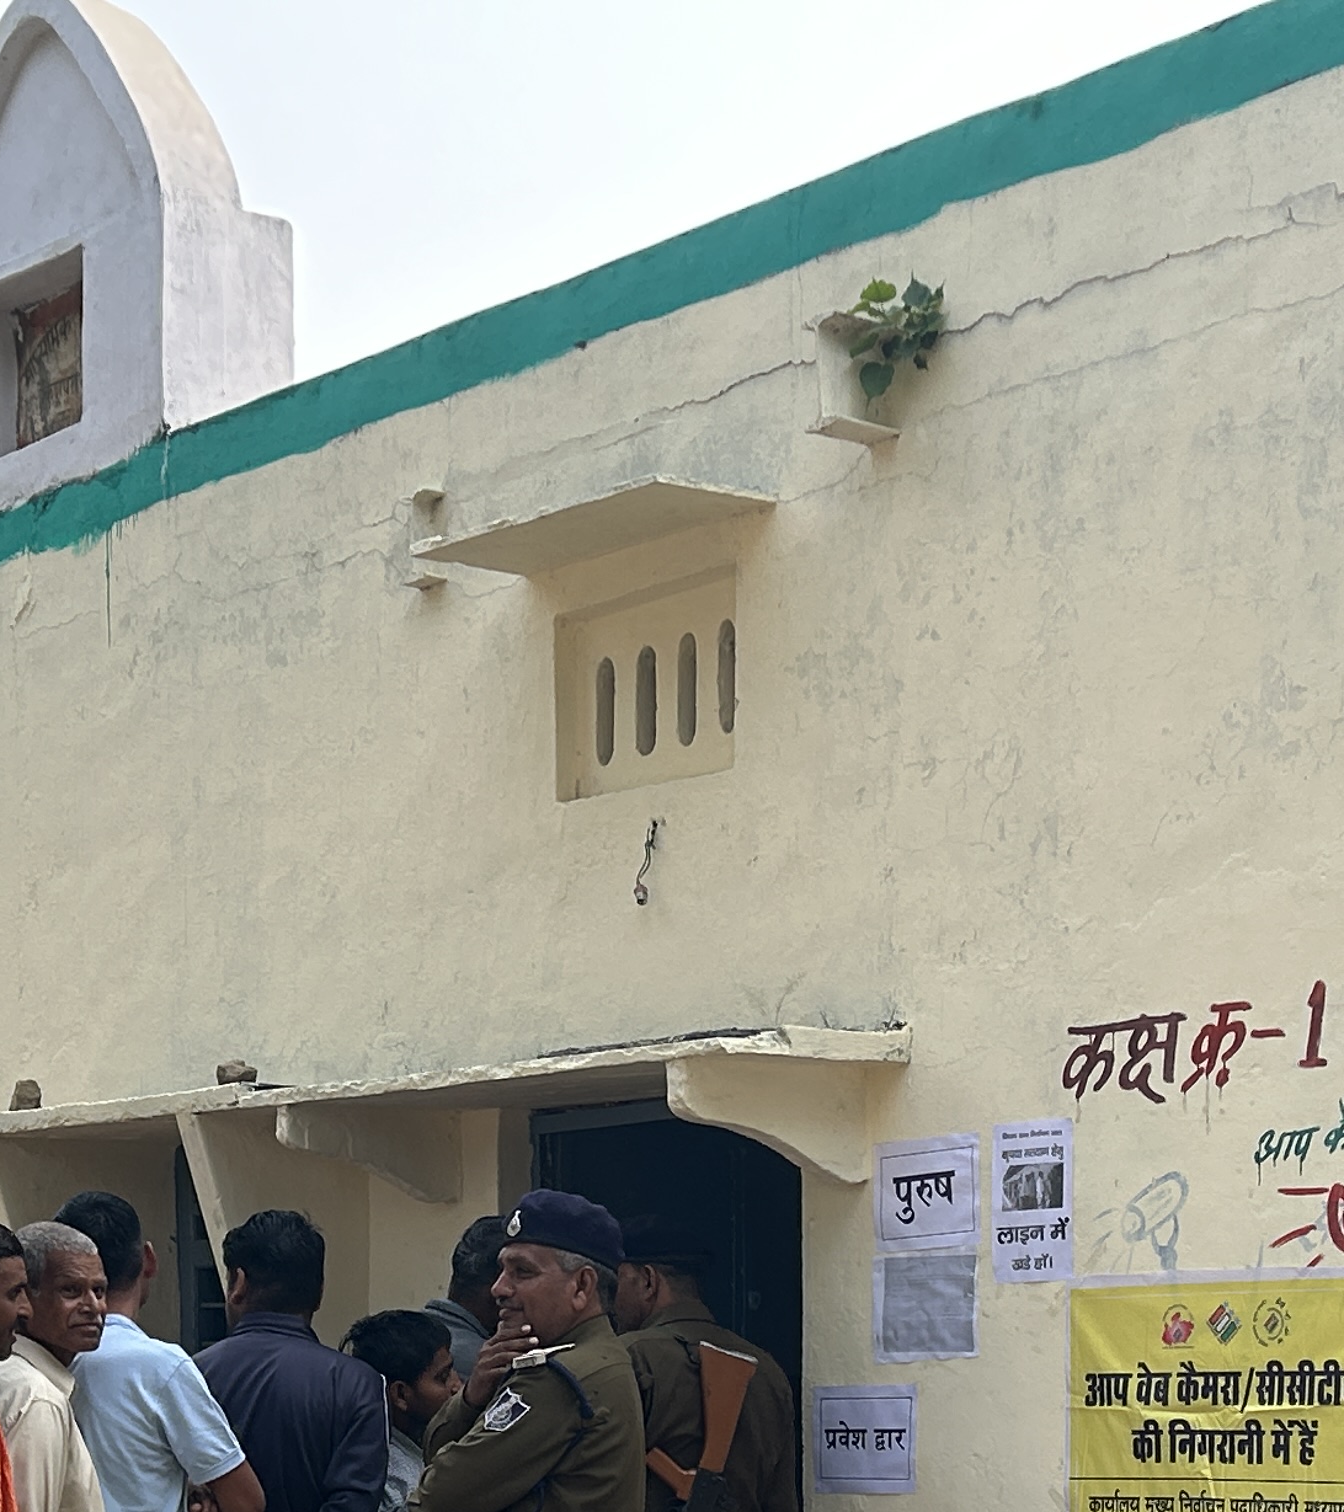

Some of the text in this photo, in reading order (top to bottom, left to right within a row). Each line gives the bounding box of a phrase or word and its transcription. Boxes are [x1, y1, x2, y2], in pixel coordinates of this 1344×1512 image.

[1062, 1013, 1187, 1102] कक्ष
[1255, 1127, 1319, 1164] आप
[893, 1169, 955, 1224] पुरुष
[996, 1217, 1070, 1245] लाइन में
[1085, 1372, 1132, 1407] आप
[1136, 1362, 1172, 1407] वेब
[825, 1421, 906, 1450] प्रवेश द्वार
[1132, 1420, 1319, 1466] की निगरानी में हैं
